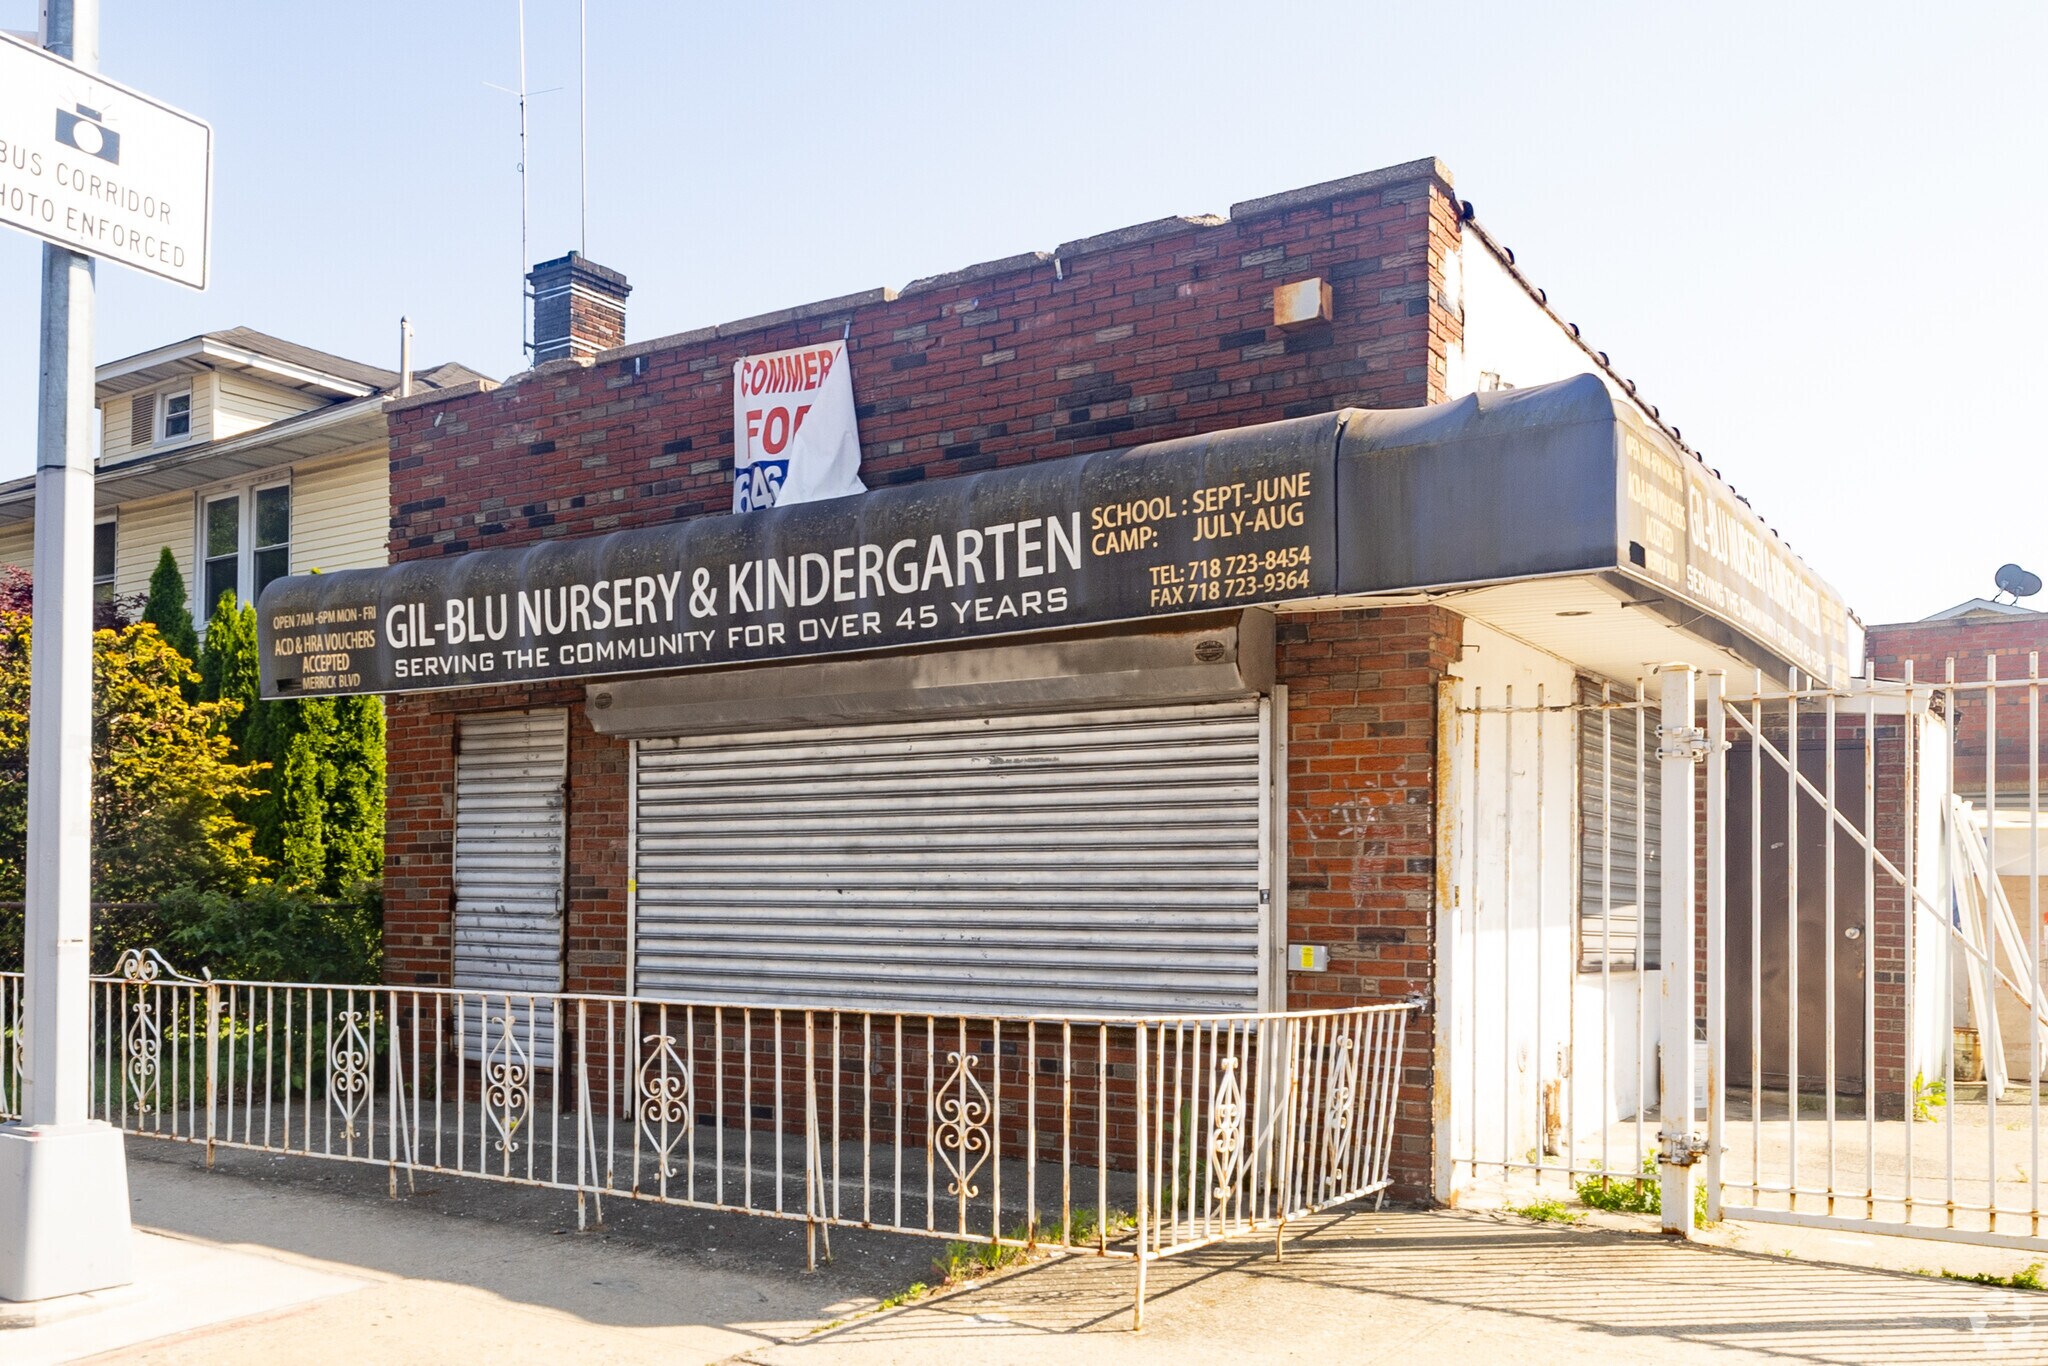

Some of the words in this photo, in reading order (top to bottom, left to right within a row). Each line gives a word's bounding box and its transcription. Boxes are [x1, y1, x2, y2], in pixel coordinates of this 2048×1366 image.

[0, 140, 42, 176] BUS
[57, 163, 171, 225] CORRIDOR
[67, 207, 185, 267] ENFORCED
[741, 346, 842, 397] COMMER
[1091, 495, 1177, 530] SCHOOL
[1192, 471, 1311, 514] SEPT-JUNE
[1091, 526, 1158, 556] CAMP:
[1193, 502, 1304, 541] JULY-AUG
[385, 593, 508, 649] GIL-BLU
[518, 570, 682, 637] NURSERY
[689, 566, 718, 619] &
[729, 511, 1082, 615] KINDERGARTEN
[1149, 564, 1184, 586] TEL:
[1188, 558, 1221, 581] 718
[1225, 545, 1311, 576] 723-8454
[1150, 585, 1184, 607] FAX
[1188, 581, 1220, 602] 718
[1224, 568, 1310, 598] 723-9364
[273, 615, 295, 630] OPEN
[296, 612, 314, 626] 7AM
[336, 608, 357, 622] MON
[363, 605, 377, 620] FRI
[275, 638, 294, 656] ACD
[295, 637, 303, 653] &
[304, 634, 322, 652] HRA
[324, 630, 376, 651] VOUCHERS
[395, 652, 495, 678] SERVING
[502, 647, 550, 669] THE
[559, 629, 715, 665] COMMUNITY
[728, 622, 786, 648] FOR
[799, 611, 881, 642] OVER
[895, 604, 938, 631] 45
[951, 587, 1068, 625] YEARS
[302, 653, 350, 673] ACCEPTED
[302, 675, 337, 690] MERRICK
[339, 673, 361, 687] BLVD
